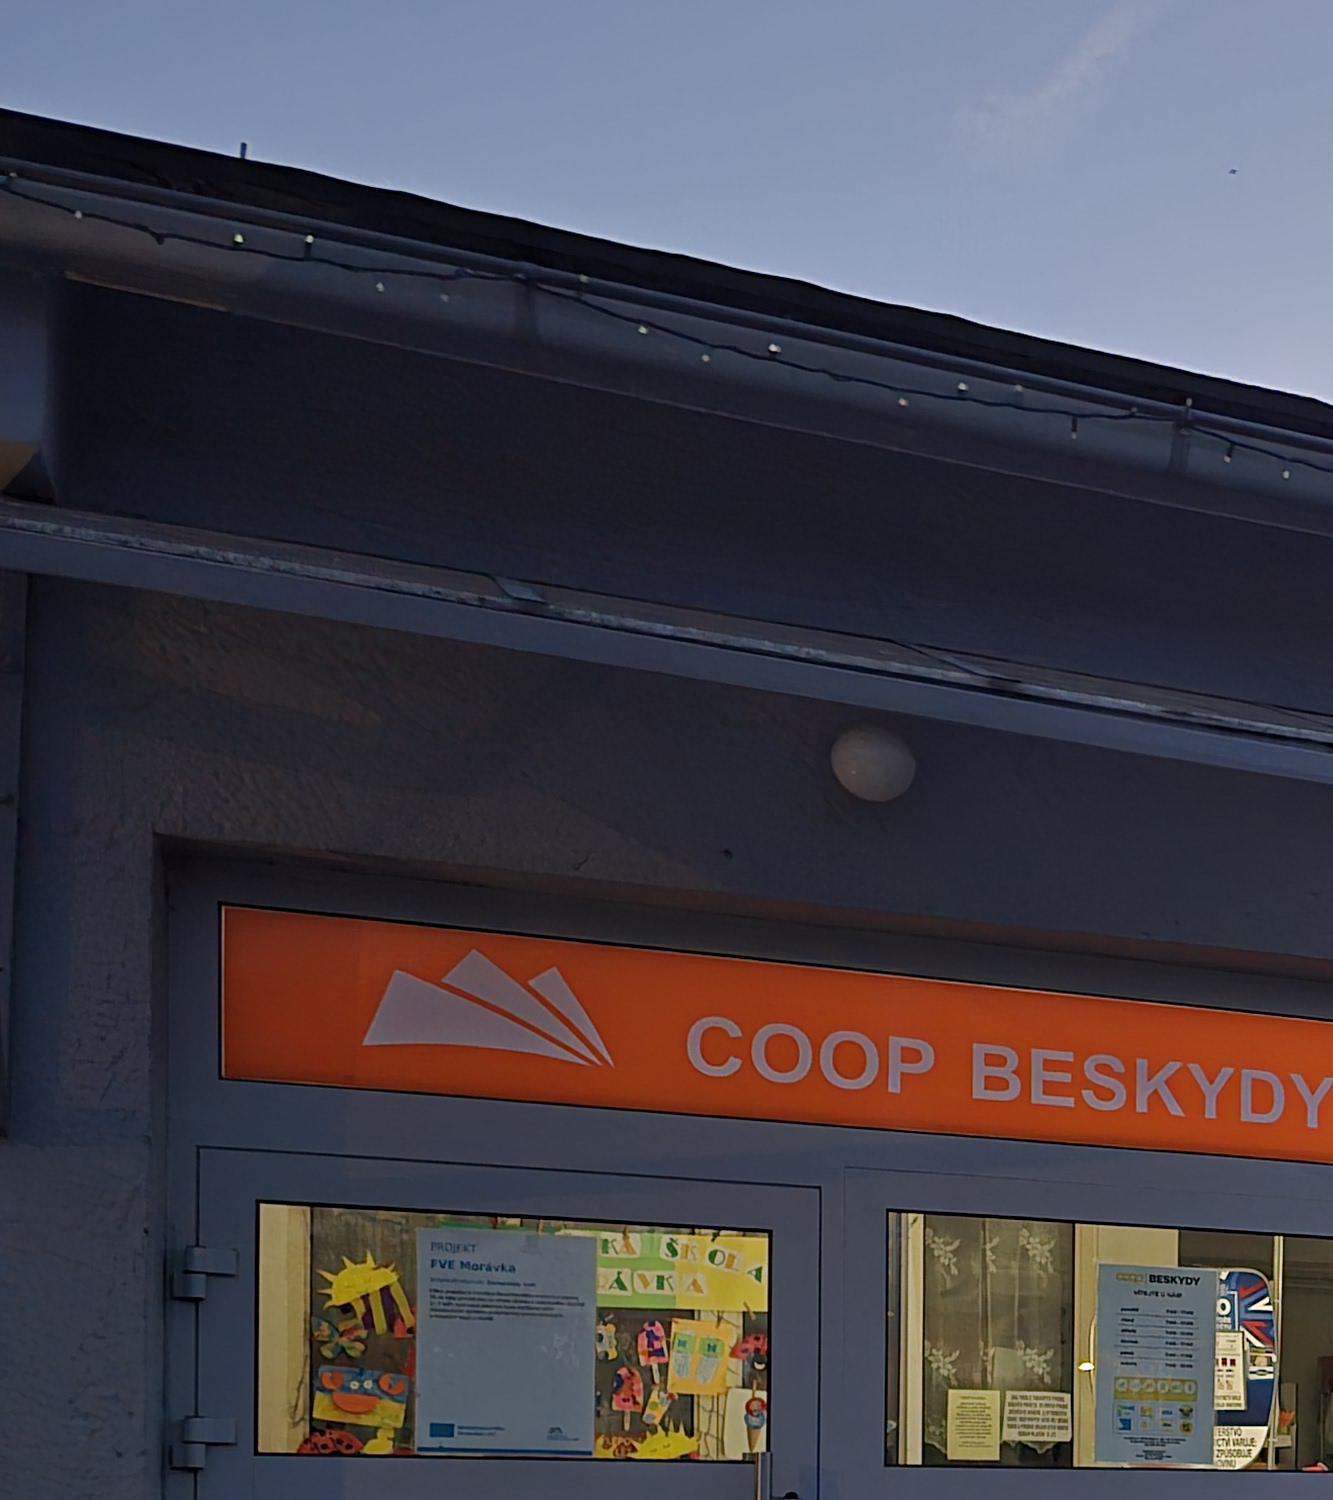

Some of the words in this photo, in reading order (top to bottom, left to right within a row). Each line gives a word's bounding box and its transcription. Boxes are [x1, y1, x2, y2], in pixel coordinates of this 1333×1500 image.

[686, 1015, 935, 1095] COOP
[430, 1259, 455, 1270] FVE
[459, 1260, 517, 1274] Morávka
[598, 1270, 705, 1295] ÁVKA
[1148, 1274, 1201, 1286] BESKYDY
